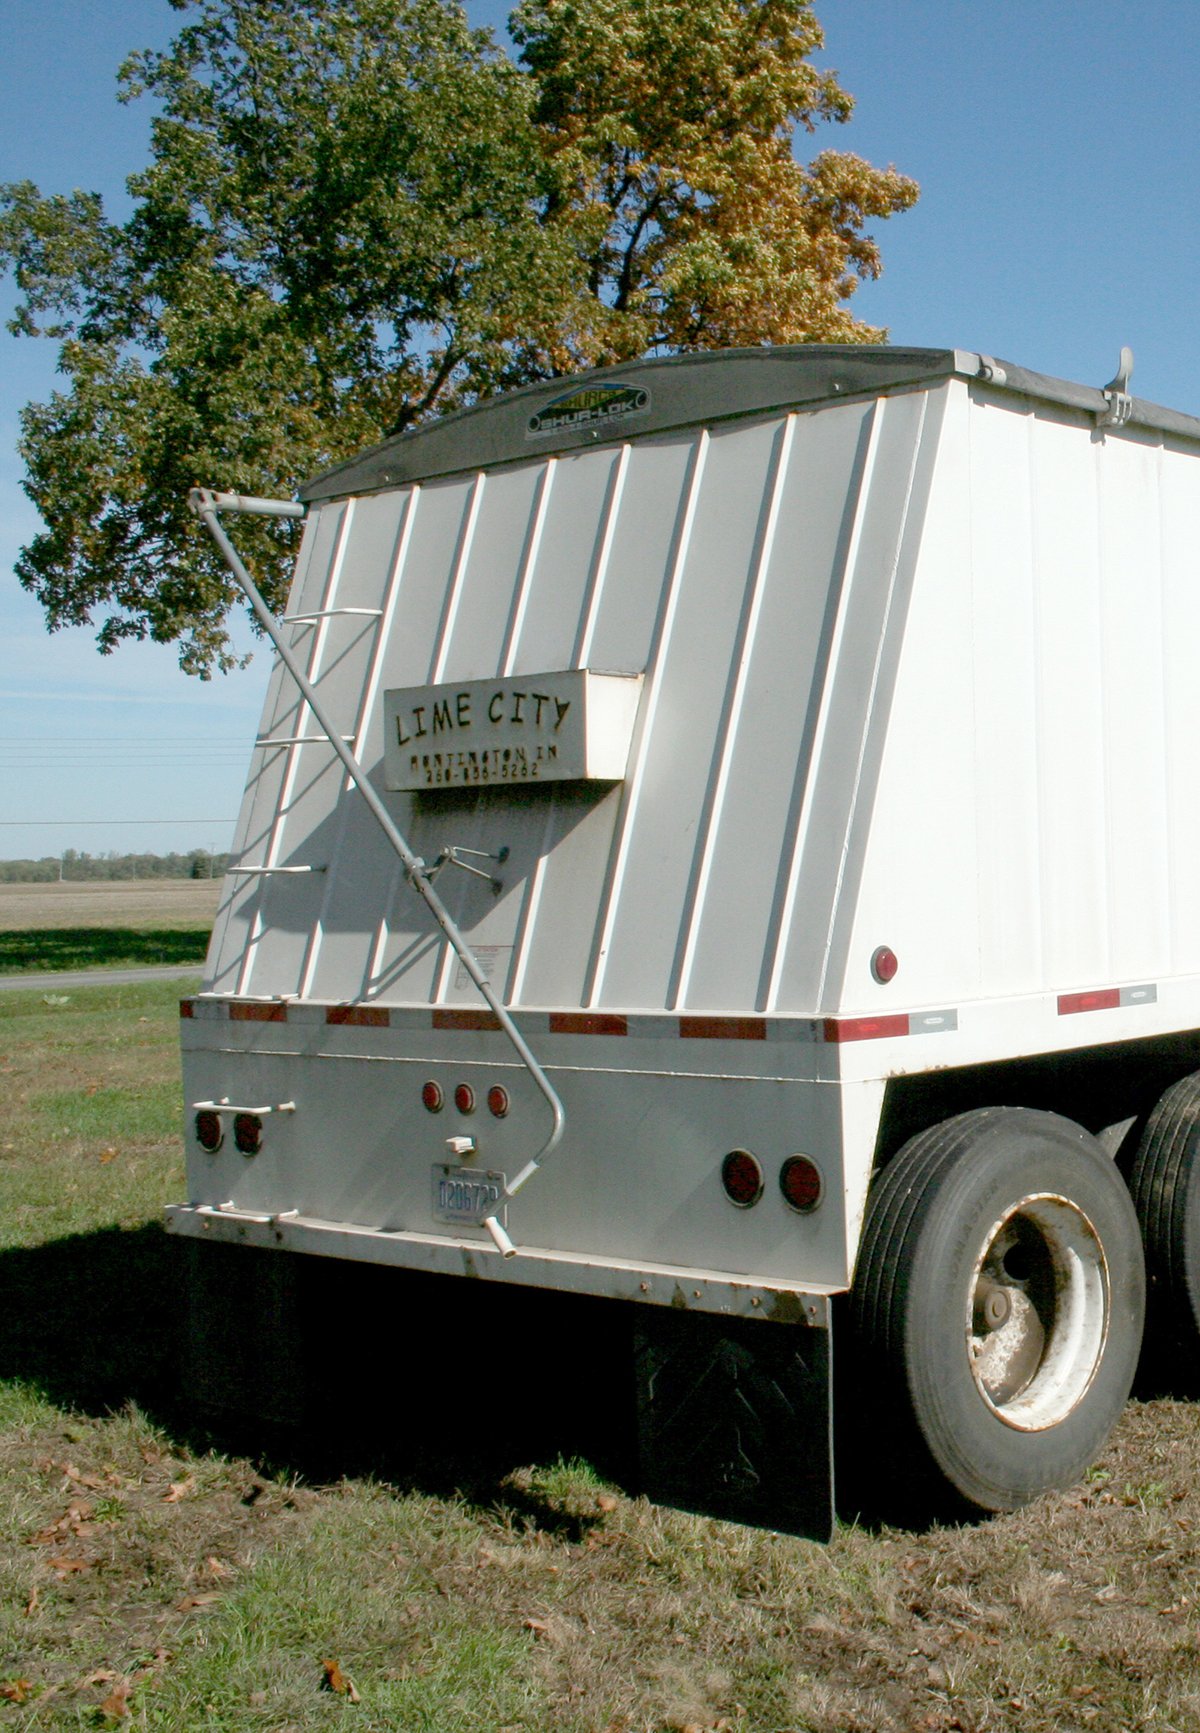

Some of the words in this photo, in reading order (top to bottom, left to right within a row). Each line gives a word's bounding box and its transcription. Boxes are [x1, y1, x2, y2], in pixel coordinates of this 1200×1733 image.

[395, 692, 472, 746] LIME
[488, 691, 571, 731] CITY
[537, 744, 558, 760] IN
